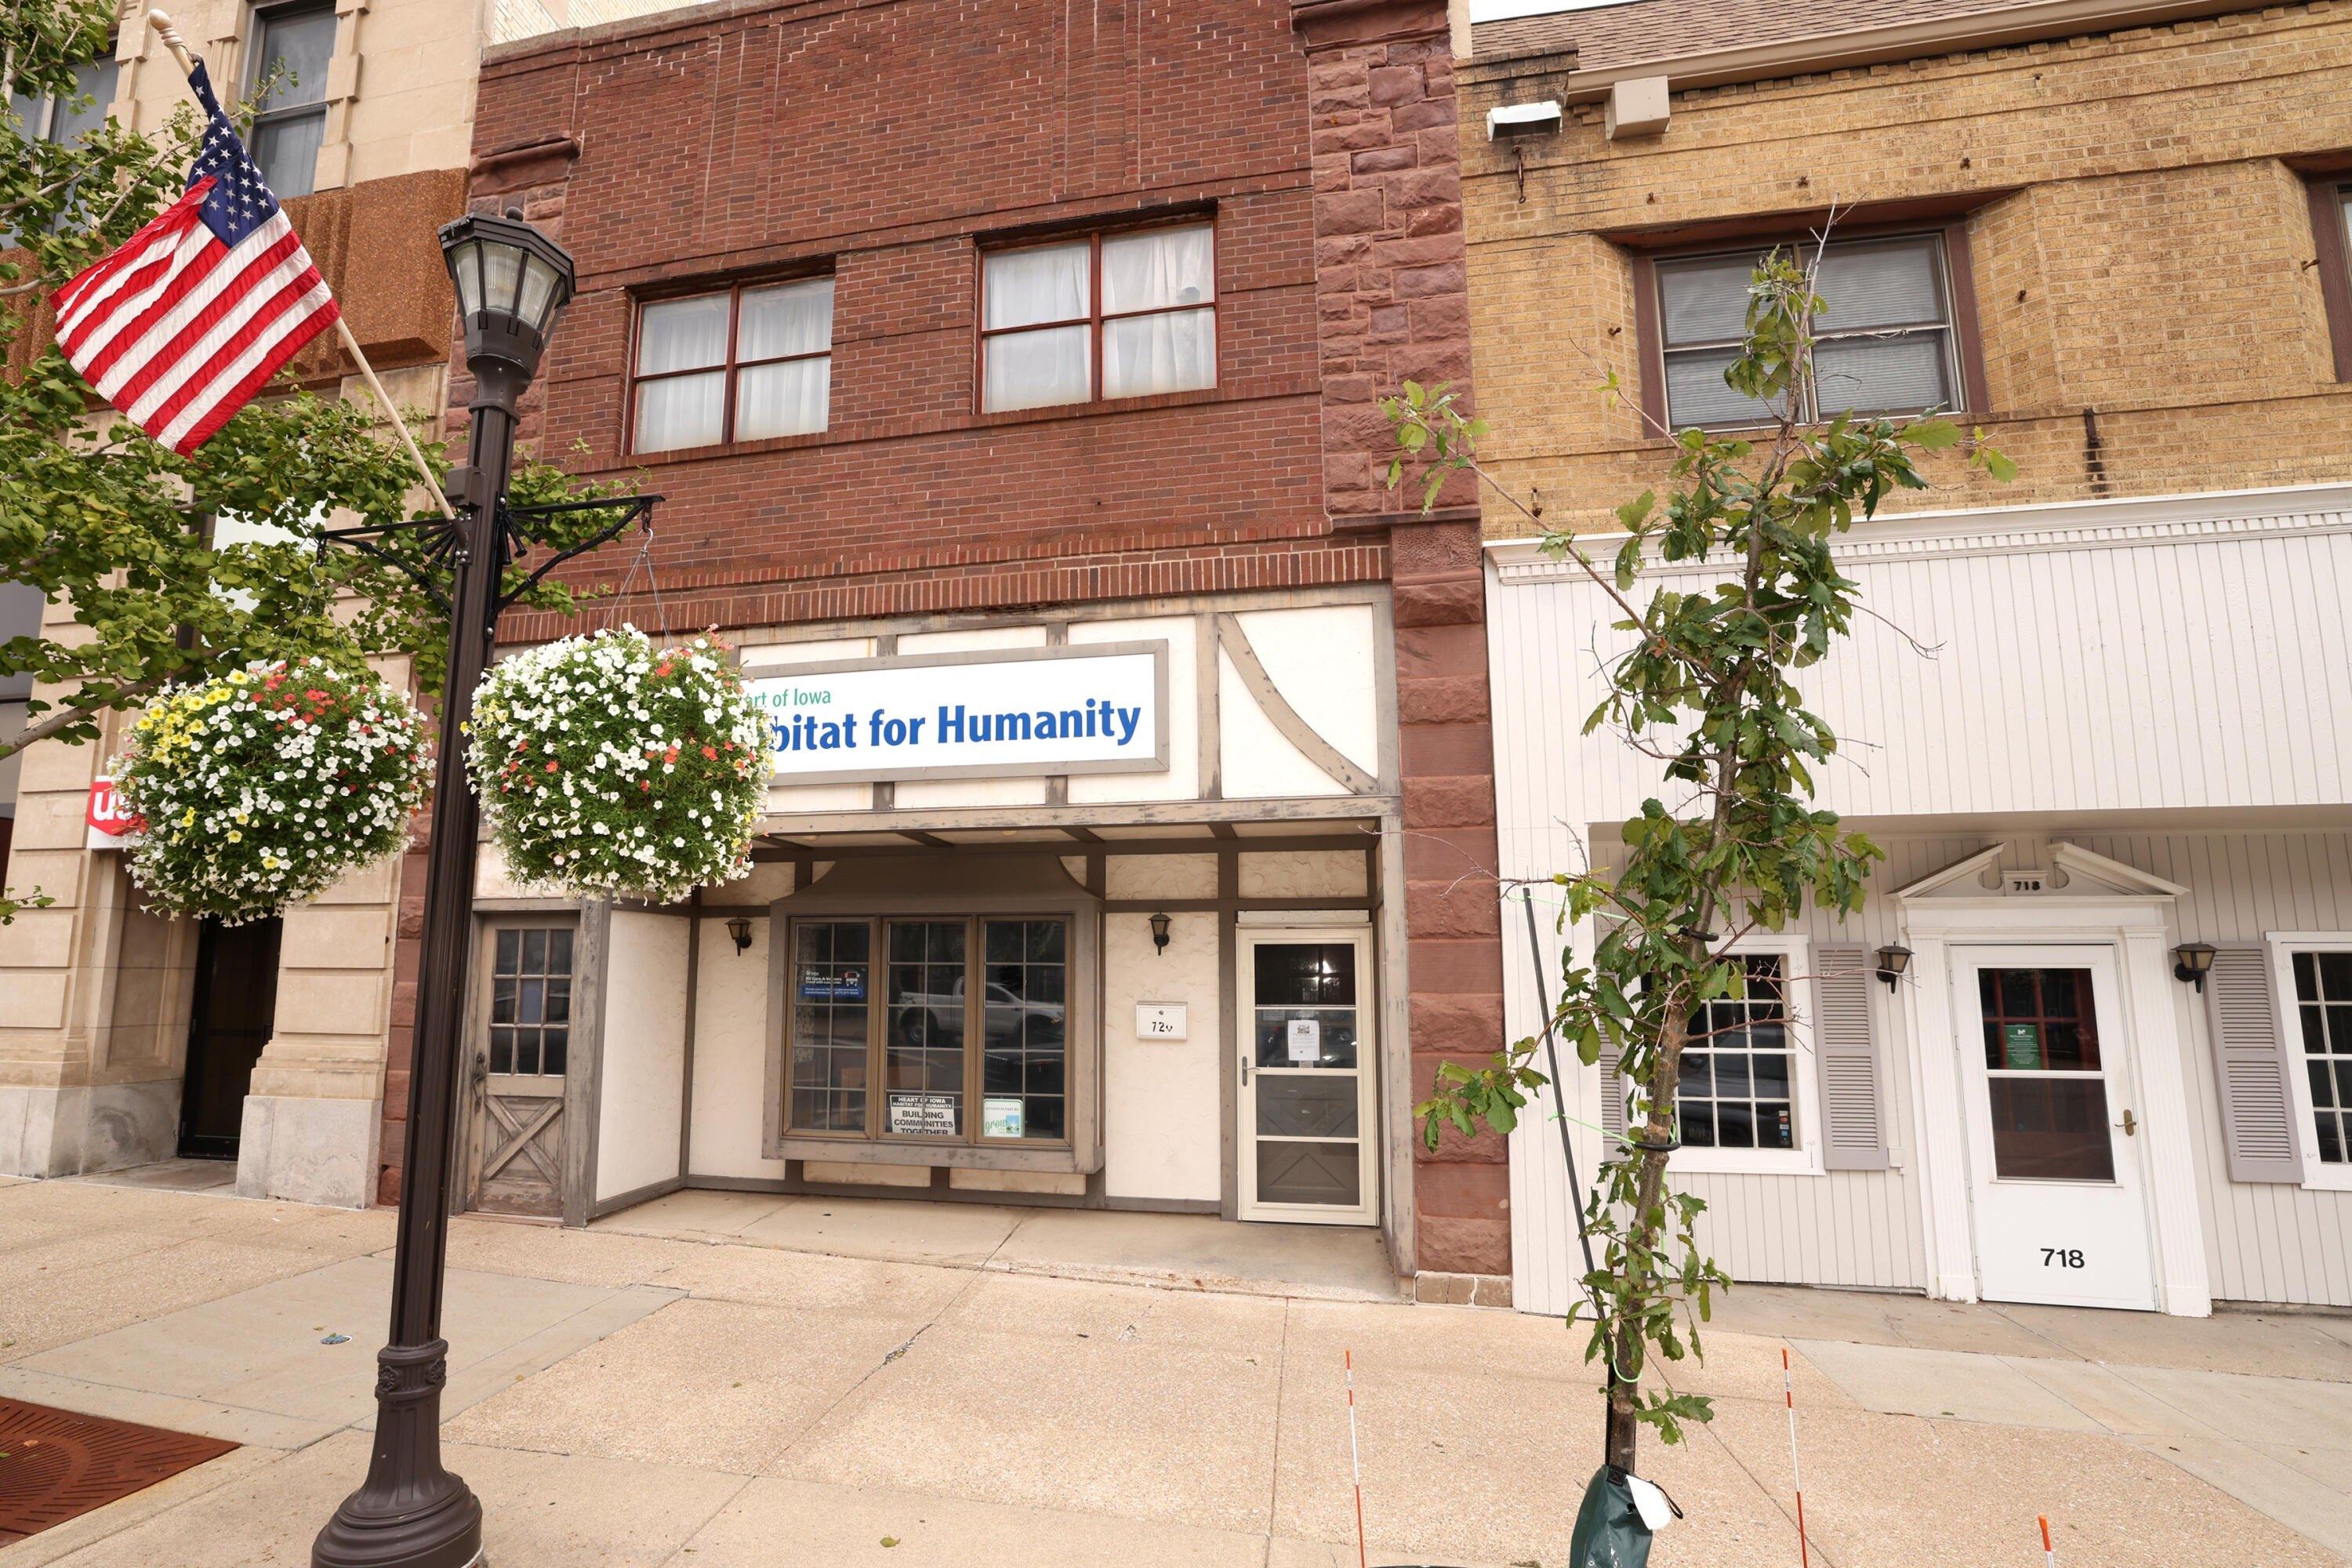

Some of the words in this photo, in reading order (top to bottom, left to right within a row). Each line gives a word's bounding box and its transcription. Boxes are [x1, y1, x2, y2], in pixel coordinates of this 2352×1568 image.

[746, 692, 767, 706] art
[773, 689, 788, 707] of
[794, 688, 831, 706] Iowa
[767, 713, 857, 752] bitat
[869, 709, 925, 746] for
[938, 698, 1142, 746] Humanity
[2013, 880, 2040, 891] 718
[902, 1110, 944, 1119] BUILDING
[894, 1119, 953, 1128] COMMUNITIES
[2040, 1248, 2085, 1269] 718
